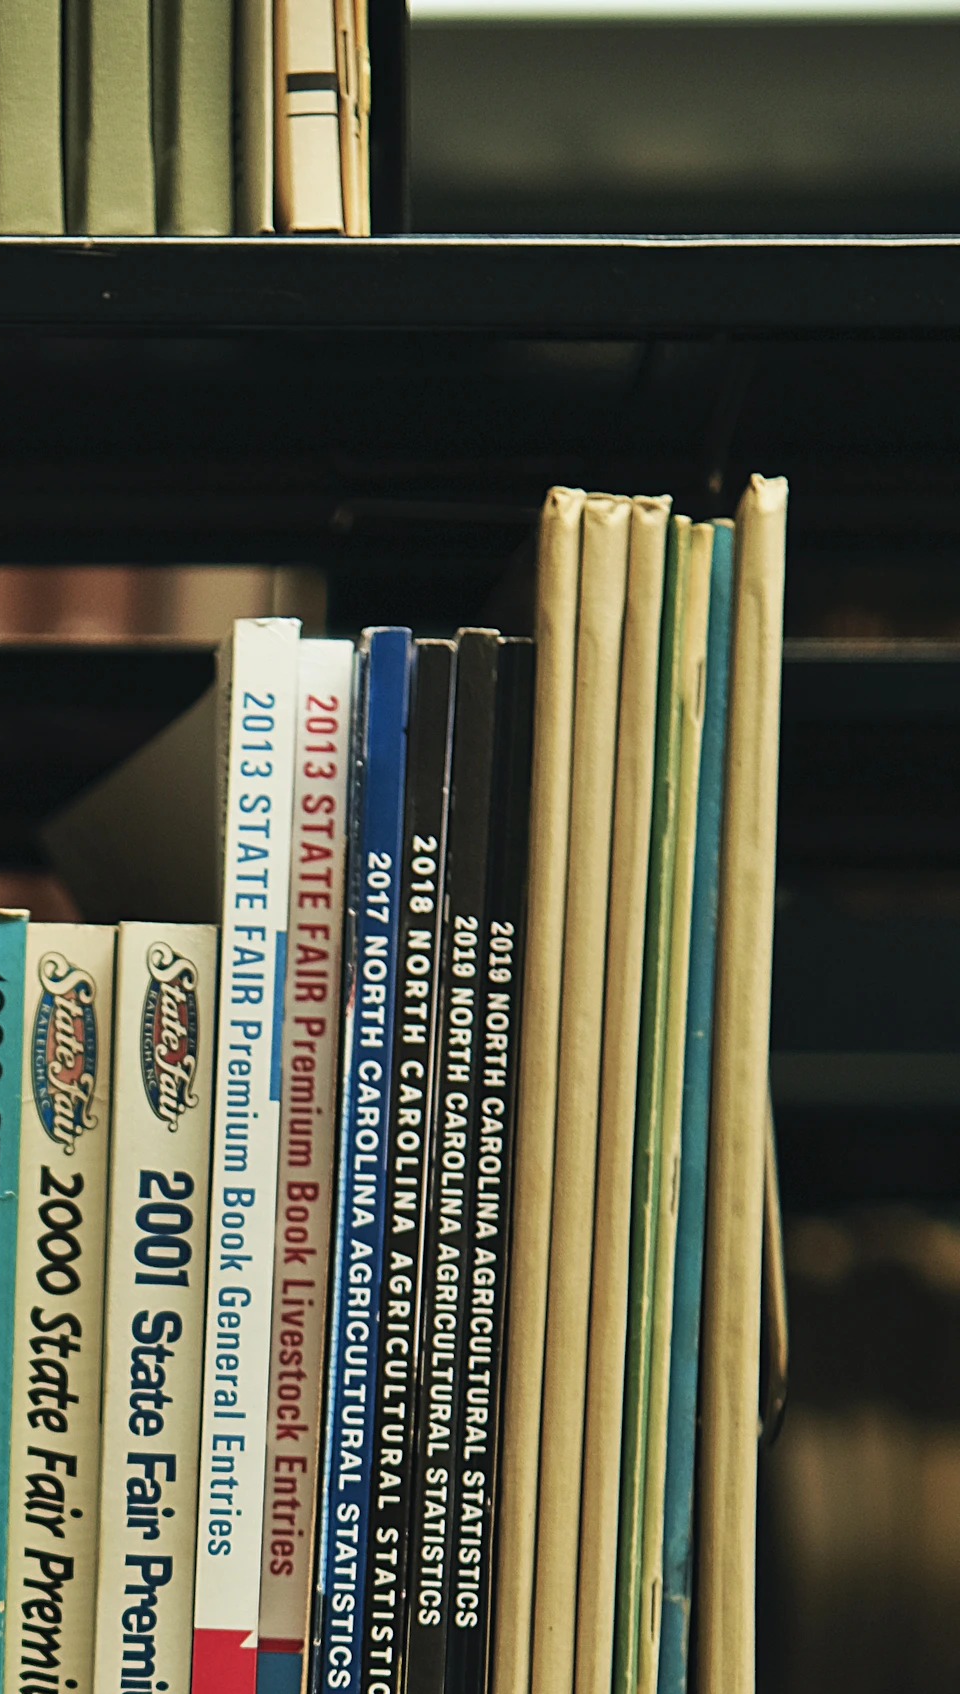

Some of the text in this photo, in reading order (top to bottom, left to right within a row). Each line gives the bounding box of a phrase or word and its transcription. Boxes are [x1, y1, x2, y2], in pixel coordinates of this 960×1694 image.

[408, 834, 439, 914] 2018
[39, 951, 98, 1156] State Fair
[146, 941, 199, 1133] State Fair
[401, 928, 431, 1044] NORTH
[207, 691, 276, 1557] 2013 STATE FAIR Premium Book General Entries
[269, 693, 339, 1577] 2013 STATE FAIR Premium Book Livestock Entries
[391, 1058, 425, 1235] CAROLINA
[34, 1164, 86, 1297] 2000
[132, 1168, 196, 1290] 2001
[327, 851, 393, 1690] 2017 NORTH CAROLINA AGRICULTURAL STATISTICS
[417, 914, 479, 1626] 2019 NORTH CAROLINA AGRICULTURAL STATISTICS
[454, 920, 515, 1629] 2019 NORTH CAROLINA AGRICULTURAL STATISTICS
[26, 1307, 83, 1435] State
[127, 1309, 184, 1438] State
[377, 1250, 414, 1510] AGRICULTURAL
[24, 1445, 83, 1539] Fair
[124, 1451, 178, 1542] Fair
